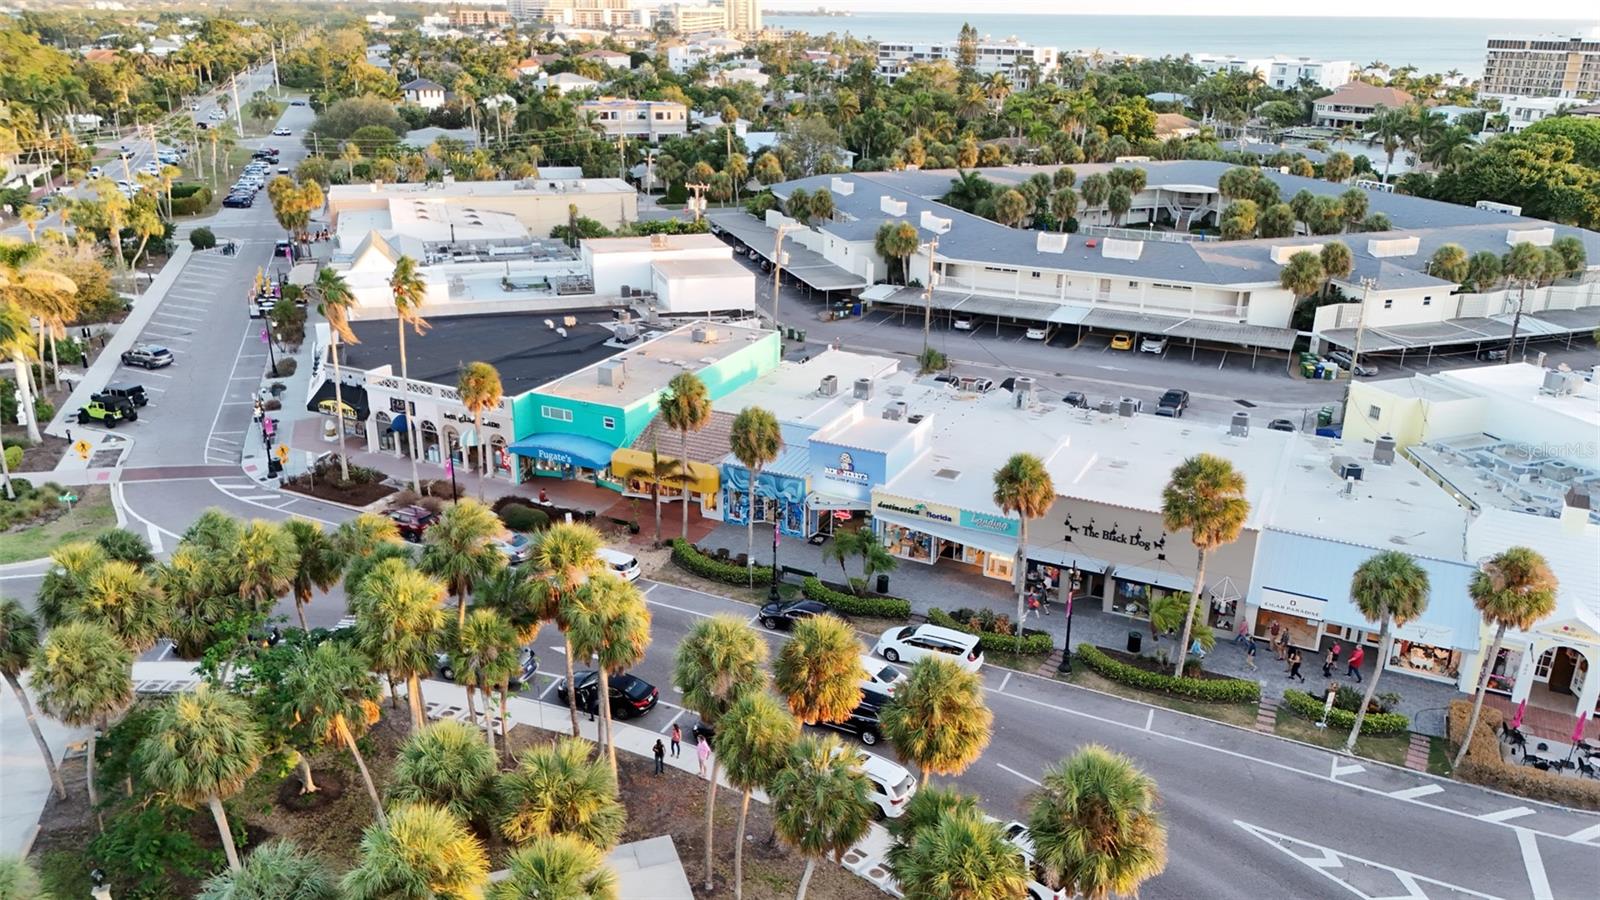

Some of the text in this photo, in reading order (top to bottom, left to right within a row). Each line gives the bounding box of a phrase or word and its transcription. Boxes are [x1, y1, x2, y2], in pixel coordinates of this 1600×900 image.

[538, 450, 572, 463] Fugate's
[1082, 525, 1151, 551] The Black Dog
